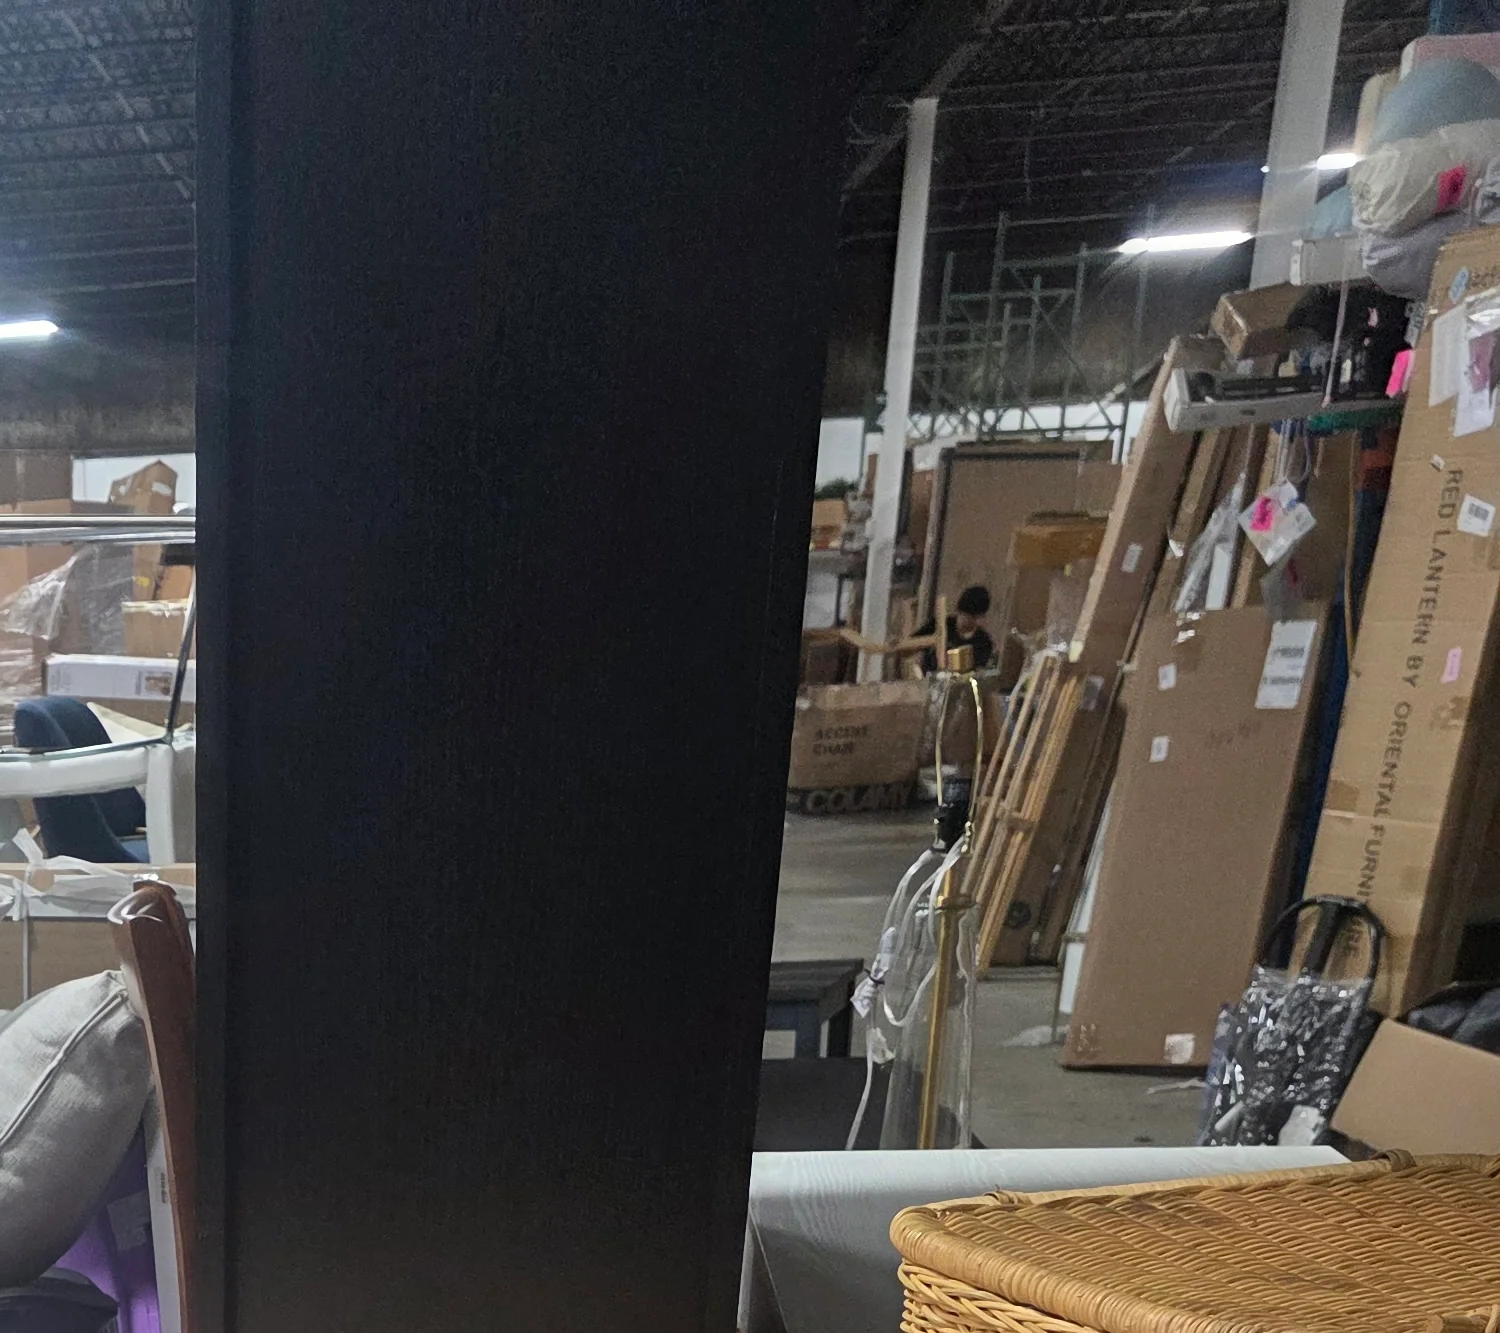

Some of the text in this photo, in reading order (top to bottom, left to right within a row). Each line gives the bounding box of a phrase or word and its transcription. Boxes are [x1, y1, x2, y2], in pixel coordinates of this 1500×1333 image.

[1438, 468, 1463, 518] RED
[1411, 529, 1452, 644] LANTERN
[1402, 655, 1424, 688] BY
[1373, 701, 1412, 818] ORIENTAL
